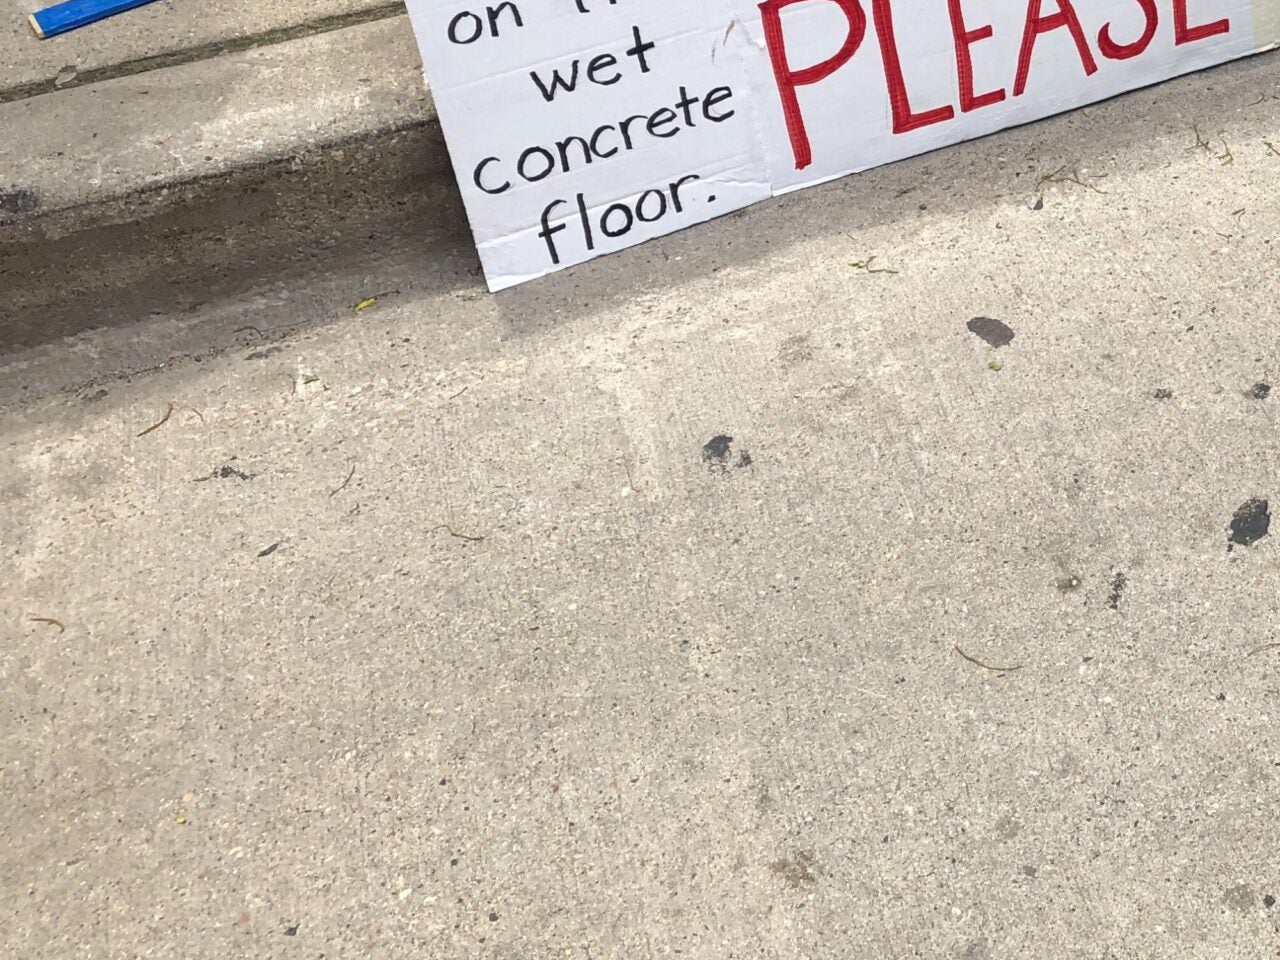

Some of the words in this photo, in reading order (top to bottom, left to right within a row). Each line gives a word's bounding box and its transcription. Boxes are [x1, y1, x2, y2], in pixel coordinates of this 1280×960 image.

[447, 1, 524, 44] on
[529, 25, 655, 102] wet
[473, 86, 735, 194] concrete
[538, 174, 716, 264] floor.
